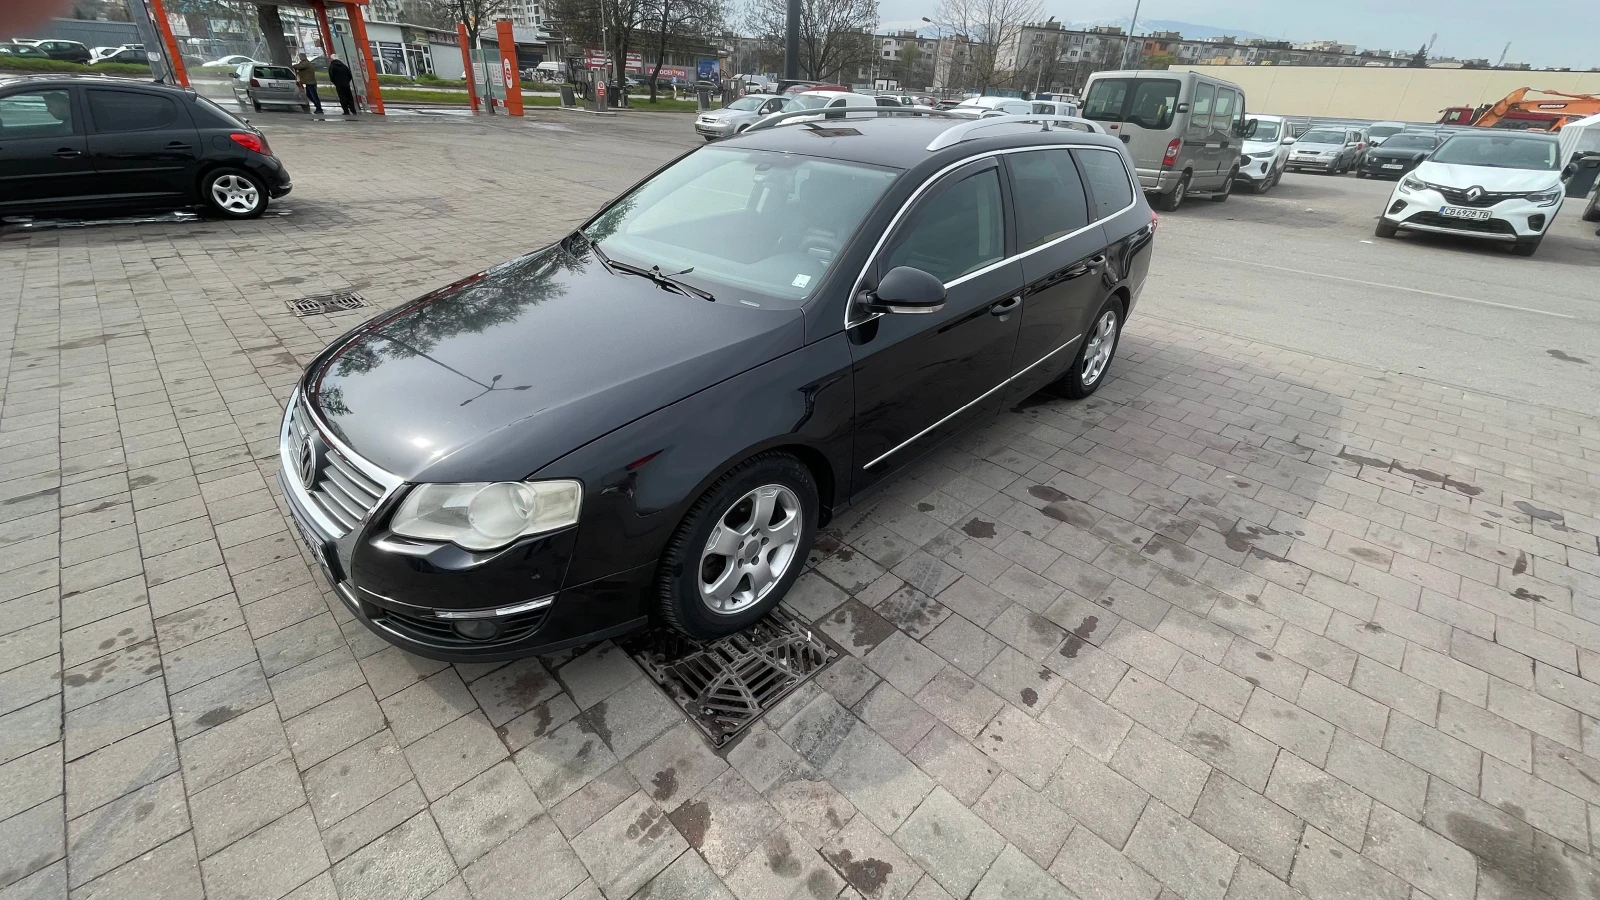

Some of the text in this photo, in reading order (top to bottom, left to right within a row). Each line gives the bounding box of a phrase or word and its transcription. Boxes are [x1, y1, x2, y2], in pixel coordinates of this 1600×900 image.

[1444, 208, 1489, 219] CB 6928 TB
